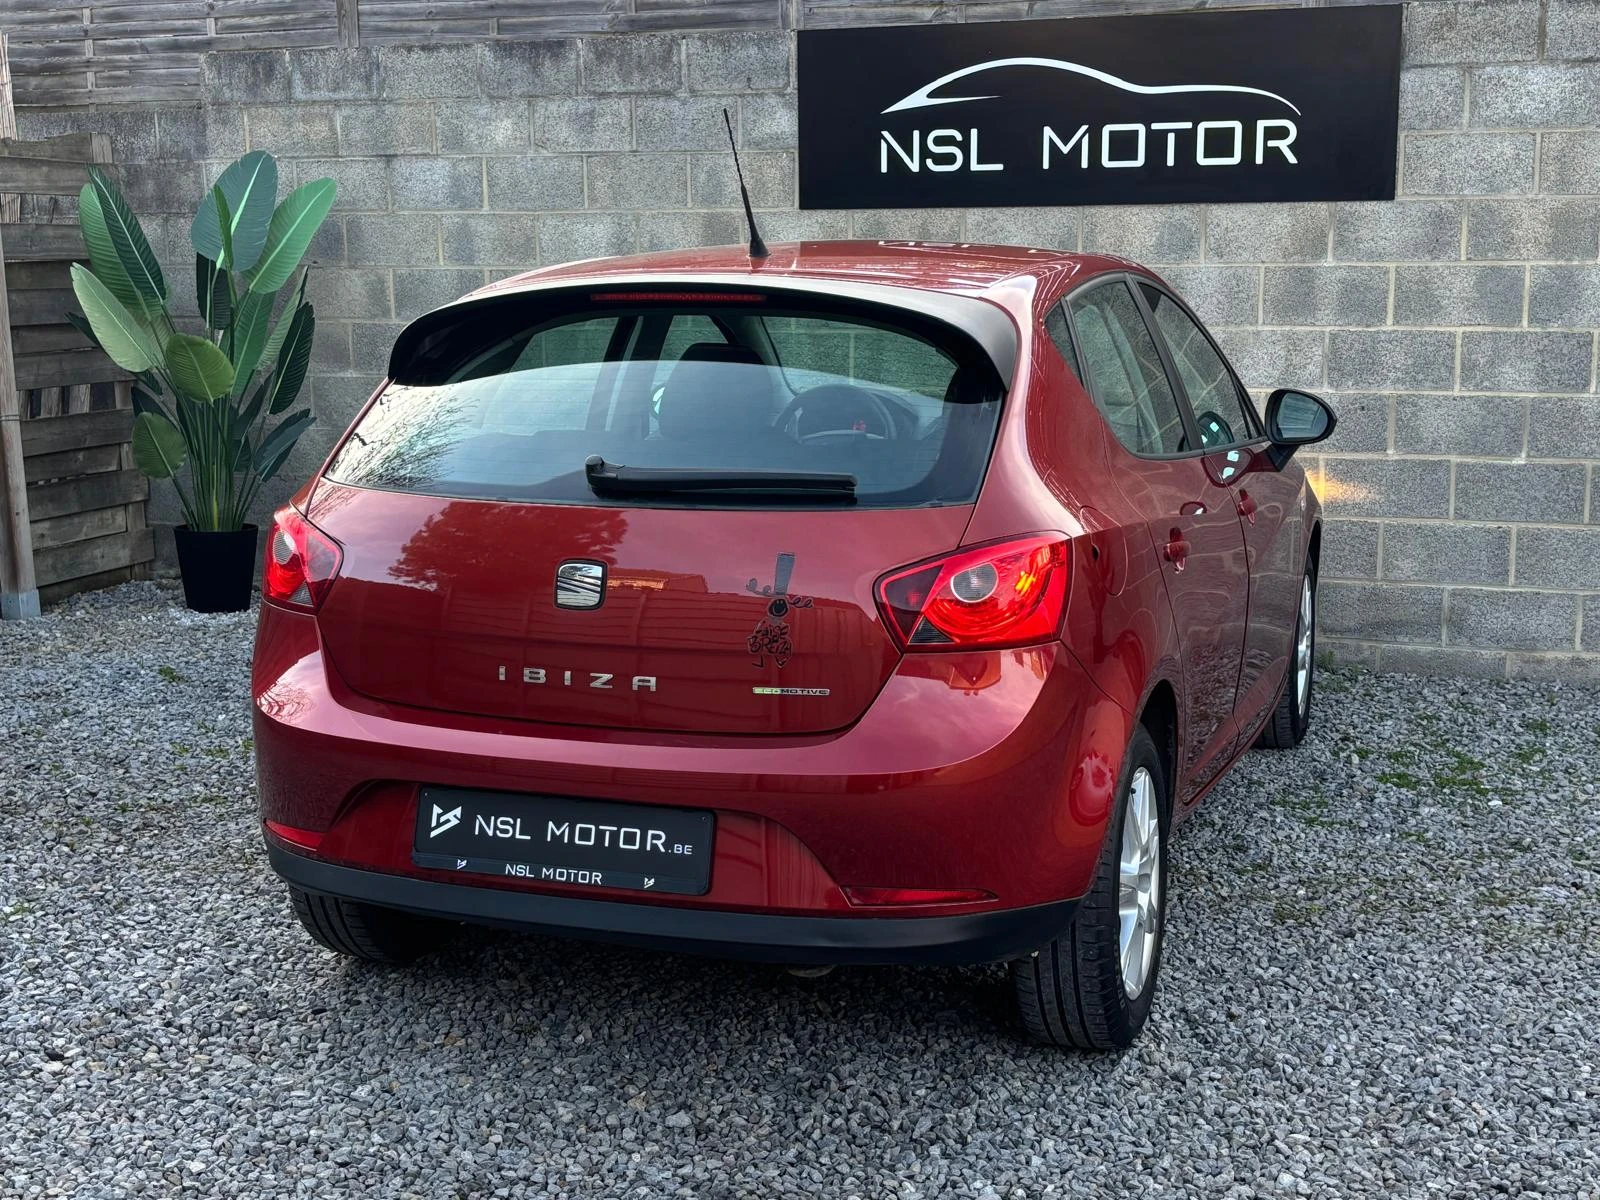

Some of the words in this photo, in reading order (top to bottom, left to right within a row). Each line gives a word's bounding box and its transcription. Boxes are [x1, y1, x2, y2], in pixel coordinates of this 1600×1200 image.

[880, 128, 1004, 173] NSL
[1042, 119, 1299, 169] MOTOR
[498, 665, 657, 691] IBIZA
[474, 814, 531, 840] NSL
[505, 863, 535, 878] NSL
[542, 867, 602, 885] MOTOR
